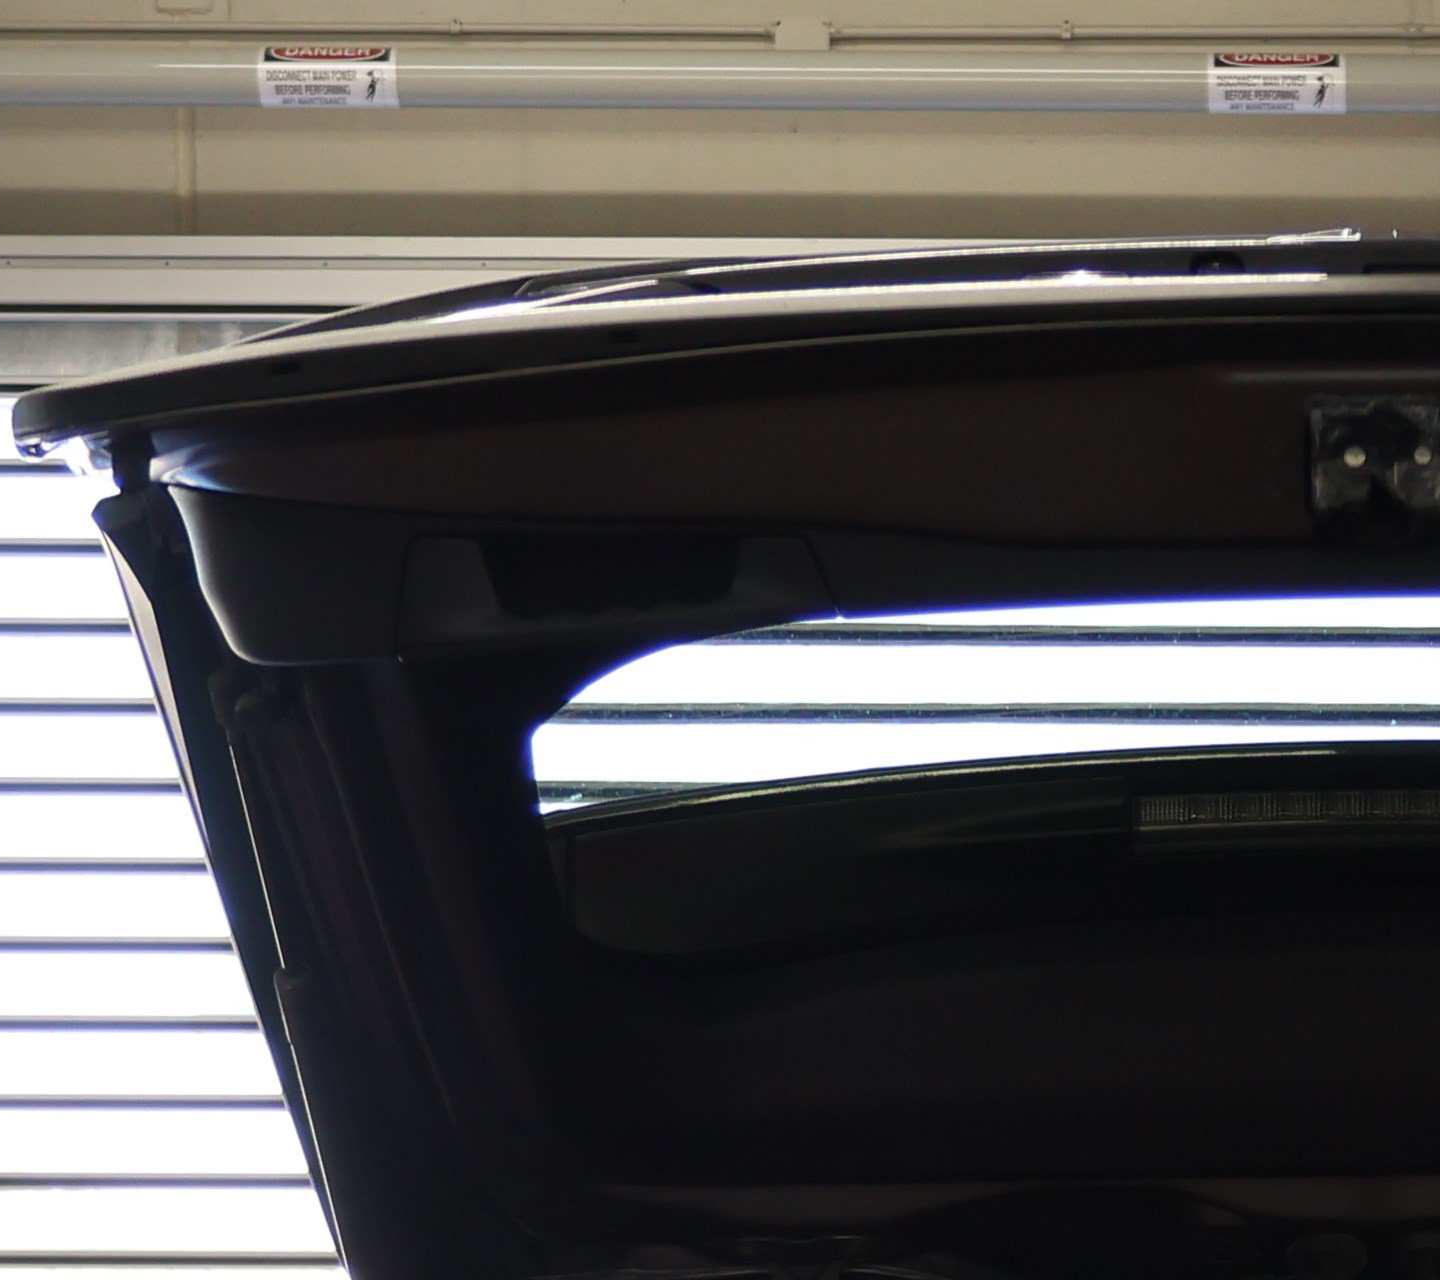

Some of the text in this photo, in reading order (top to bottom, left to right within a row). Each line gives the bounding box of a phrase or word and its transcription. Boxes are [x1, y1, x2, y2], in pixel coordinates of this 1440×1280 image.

[285, 47, 371, 56] DANGER
[266, 70, 310, 82] DISCONNECT
[331, 71, 358, 82] POWER
[275, 84, 351, 95] BEFORE PERFORMING
[1224, 90, 1300, 101] BEFORE PERFORMING
